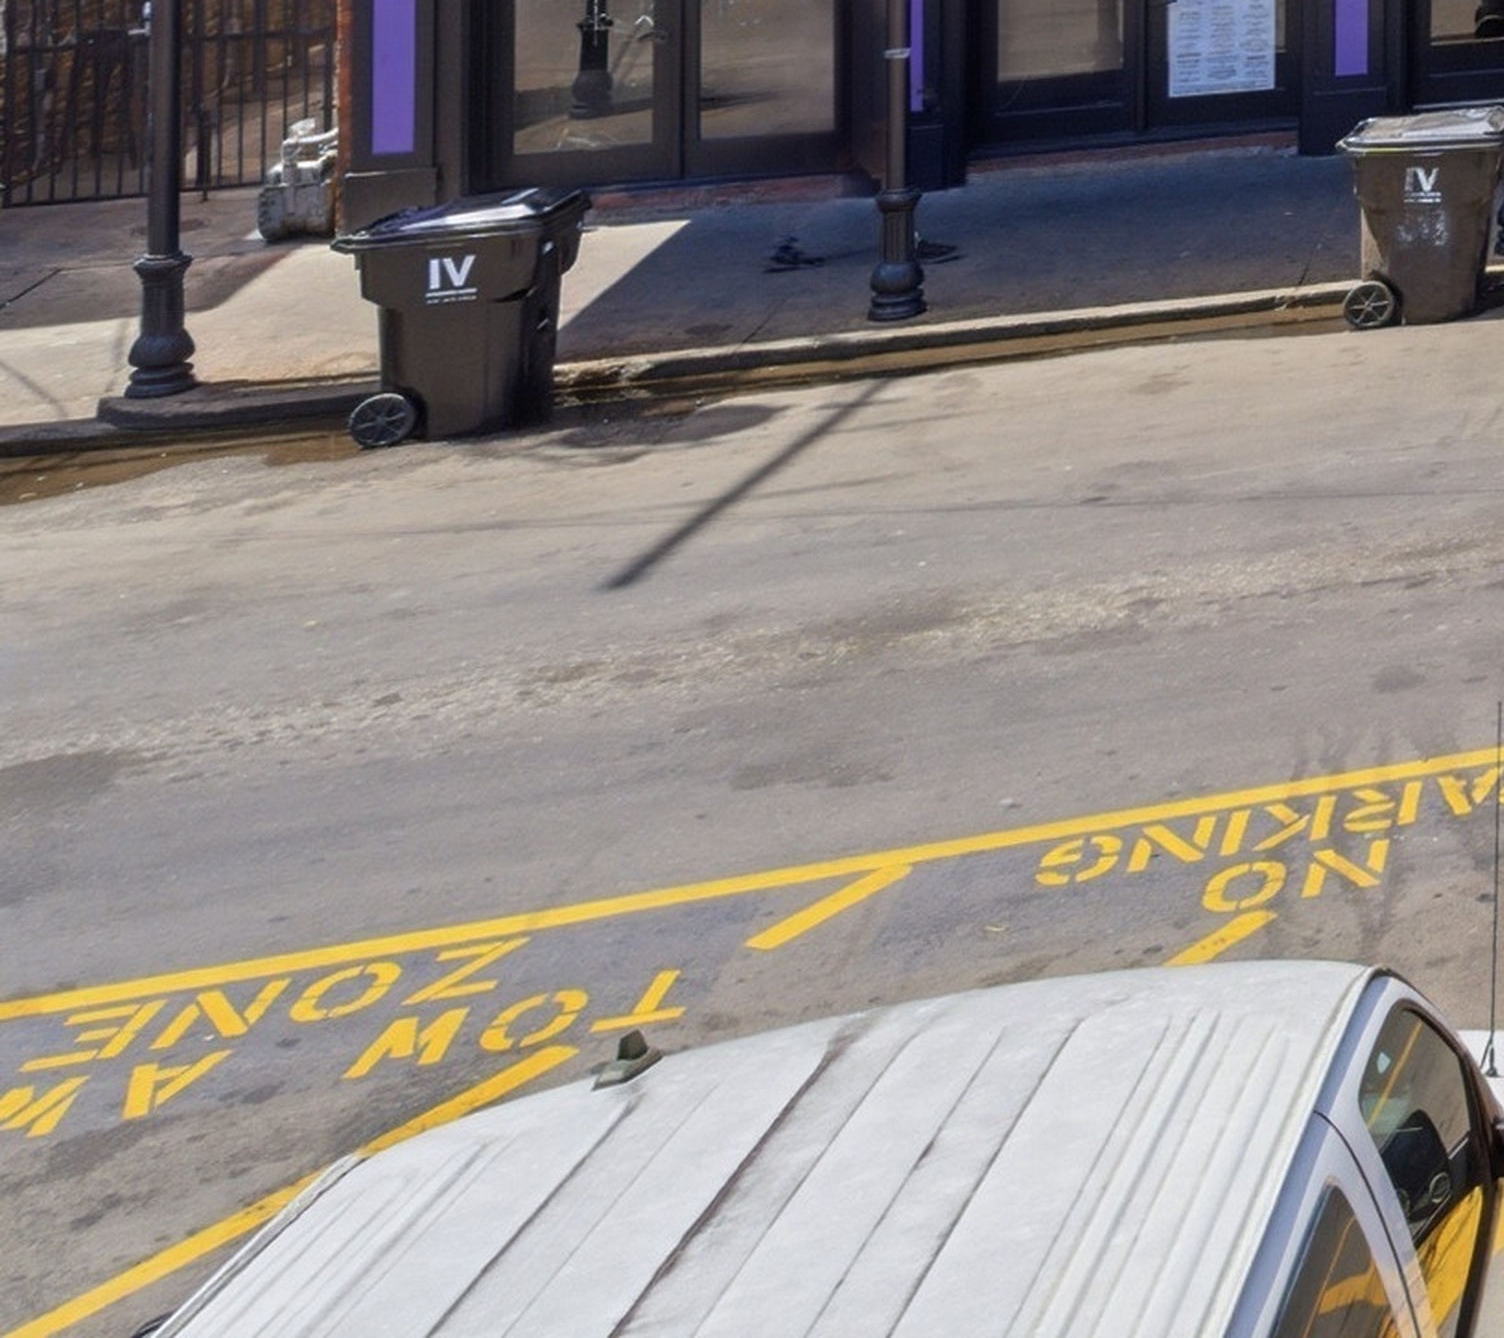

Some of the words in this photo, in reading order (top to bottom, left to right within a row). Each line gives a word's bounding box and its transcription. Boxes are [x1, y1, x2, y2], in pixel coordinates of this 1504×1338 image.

[1404, 167, 1440, 192] IV
[429, 254, 477, 290] IV
[1201, 838, 1391, 913] NO
[18, 935, 532, 1073] ZONE
[342, 969, 687, 1081] TOW
